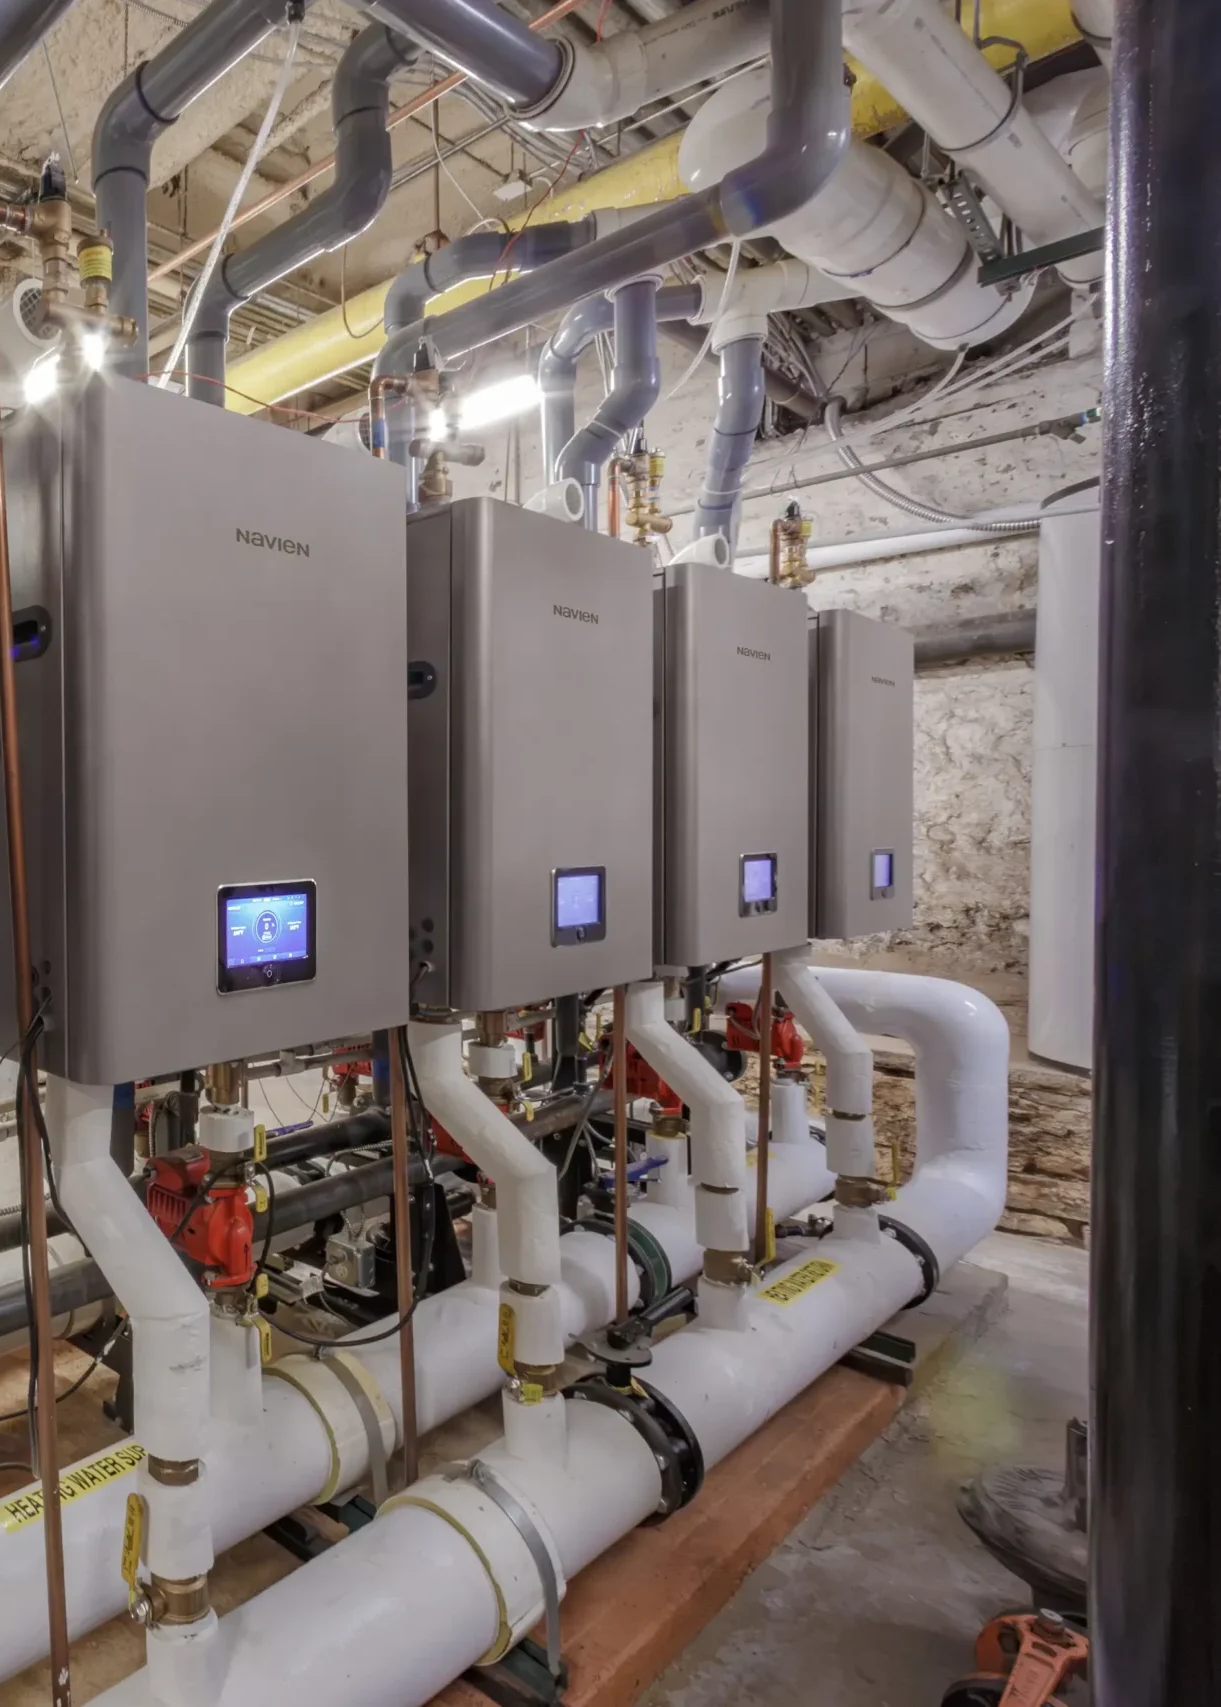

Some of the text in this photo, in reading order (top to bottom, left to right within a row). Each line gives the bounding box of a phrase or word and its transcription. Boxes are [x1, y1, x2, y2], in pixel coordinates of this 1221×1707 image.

[4, 1480, 75, 1523] HEATG
[70, 1456, 126, 1491] WATER
[116, 1444, 148, 1467] SUP
